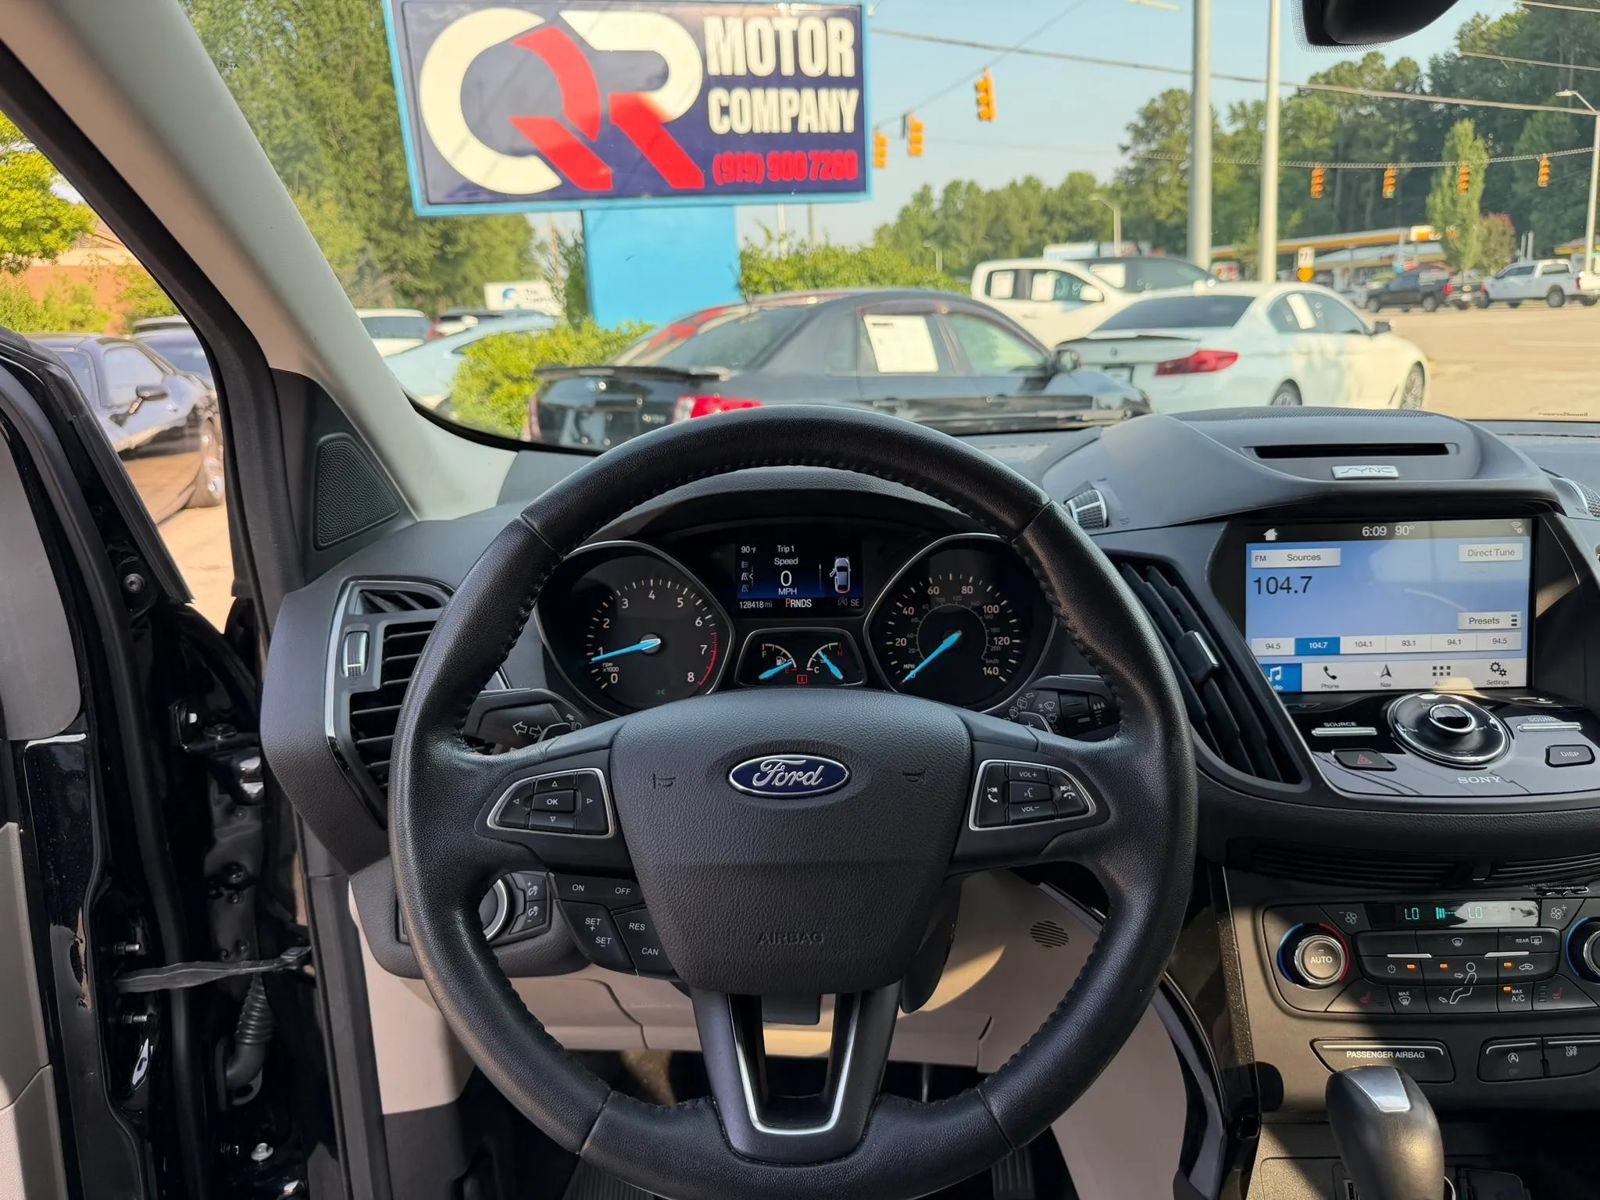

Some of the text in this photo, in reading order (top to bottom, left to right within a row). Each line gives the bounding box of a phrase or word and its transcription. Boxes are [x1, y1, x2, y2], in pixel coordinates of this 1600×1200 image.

[705, 16, 856, 78] MOTOR
[707, 87, 859, 134] COMPANY
[1362, 525, 1415, 537] 6:09 90°
[777, 545, 795, 554] Trip 1
[1467, 549, 1515, 558] Direct Tune
[774, 557, 799, 566] Speed
[1287, 553, 1321, 562] Sources
[780, 570, 792, 587] 0
[961, 585, 973, 594] 80
[1252, 576, 1313, 595] 104.7
[649, 590, 655, 600] 4
[927, 586, 940, 595] 60
[621, 599, 629, 609] 3
[677, 598, 684, 608] 5
[739, 601, 764, 609] 128418
[902, 606, 915, 615] 40
[983, 604, 1000, 613] 100
[602, 618, 610, 629] 2
[695, 617, 703, 627] 6
[1468, 616, 1500, 625] Presets
[895, 637, 907, 647] 20
[994, 636, 1010, 646] 120
[1354, 640, 1373, 649] 104.1
[1446, 637, 1462, 646] 94.1
[1492, 636, 1508, 645] 94.5
[700, 644, 708, 655] 7
[1265, 641, 1281, 650] 94.5
[1308, 641, 1328, 650] 104.7
[982, 666, 999, 676] 140
[610, 673, 618, 684] 0
[687, 671, 695, 682] 8
[1321, 682, 1340, 690] Phone
[752, 759, 825, 787] Ford
[1457, 776, 1501, 784] SONY
[546, 798, 558, 806] OK
[572, 884, 584, 892] ON
[615, 887, 632, 895] OFF
[585, 917, 601, 925] SET
[629, 922, 646, 931] RES
[595, 936, 611, 945] SET
[760, 931, 824, 945] AIRBAG
[641, 947, 658, 956] CAN
[1310, 955, 1333, 964] AUTO
[1511, 994, 1525, 1002] A/C
[1346, 1050, 1425, 1059] PASSENGER AIRBAG
